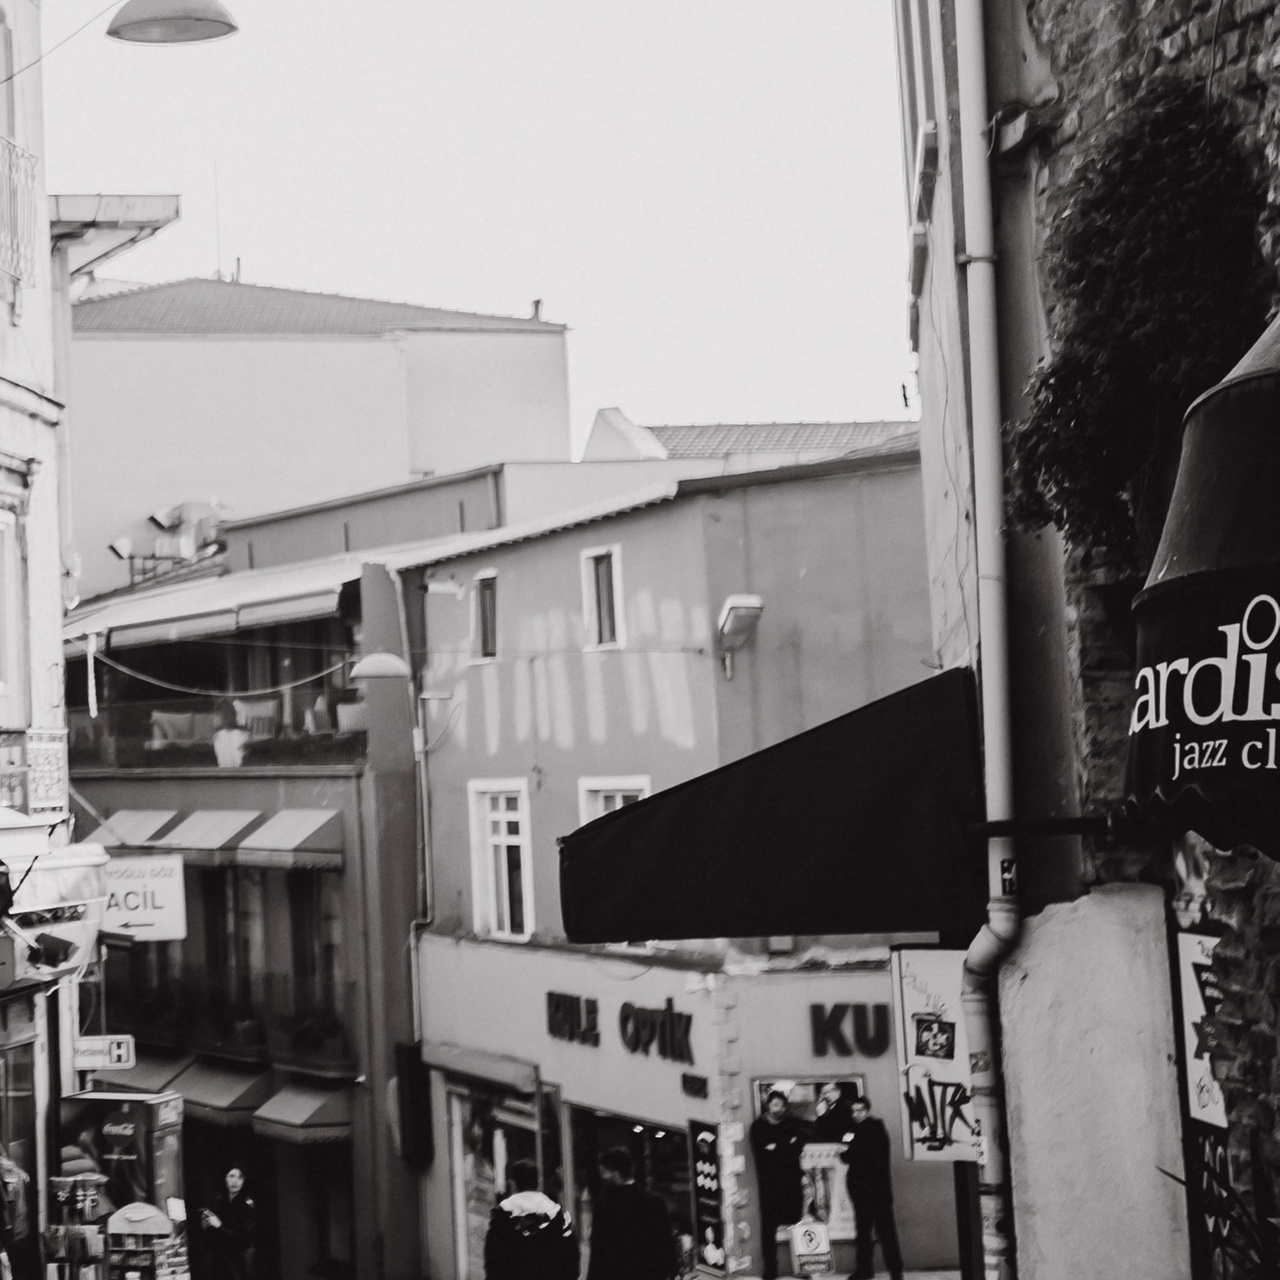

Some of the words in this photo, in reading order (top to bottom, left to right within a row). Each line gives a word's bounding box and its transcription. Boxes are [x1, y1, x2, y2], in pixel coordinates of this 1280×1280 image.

[1128, 594, 1280, 736] ardi
[1172, 732, 1229, 781] jazz
[809, 1002, 890, 1059] KU
